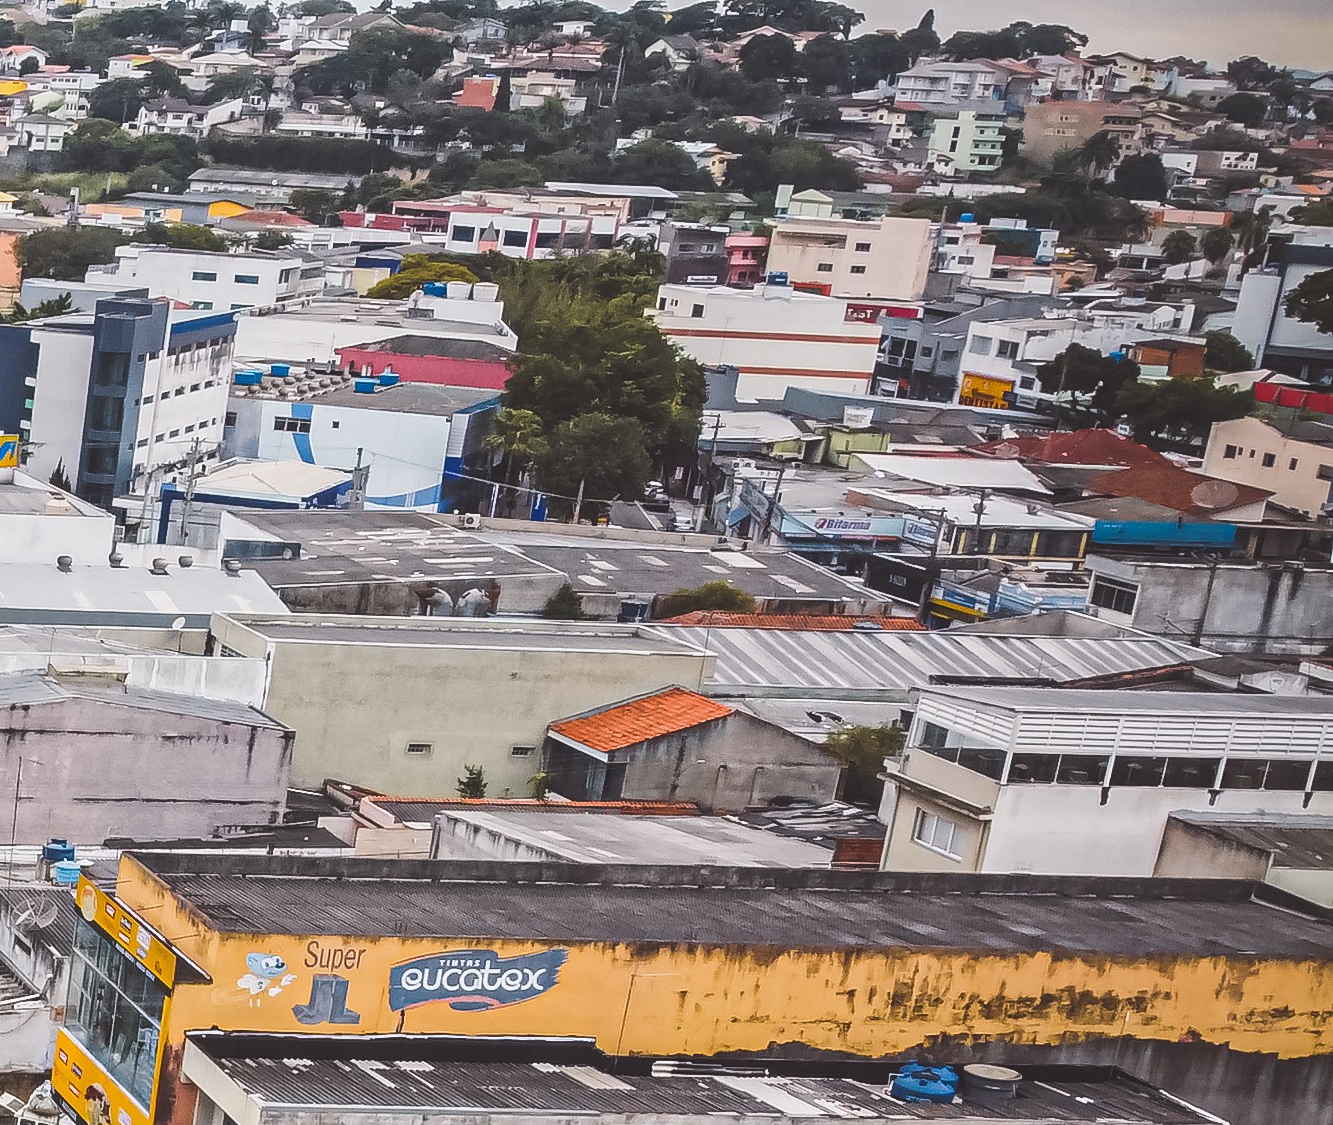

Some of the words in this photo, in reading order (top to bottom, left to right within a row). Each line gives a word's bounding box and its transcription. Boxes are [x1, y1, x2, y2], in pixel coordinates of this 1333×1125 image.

[304, 941, 366, 971] Super
[439, 959, 481, 967] TINTAS
[400, 959, 546, 991] eucatex
